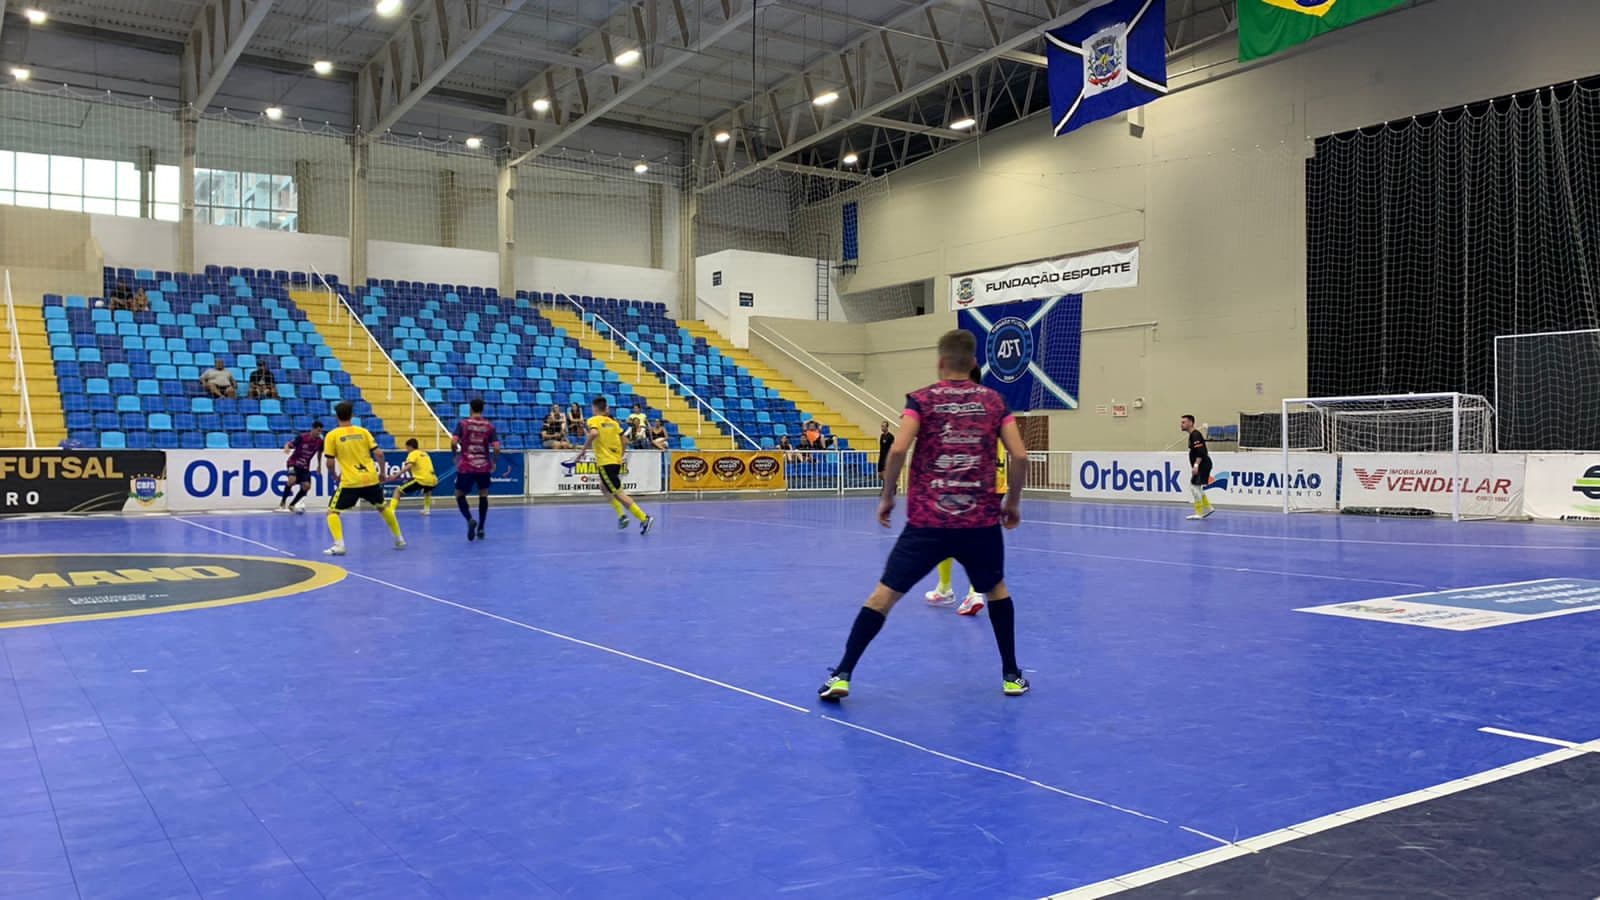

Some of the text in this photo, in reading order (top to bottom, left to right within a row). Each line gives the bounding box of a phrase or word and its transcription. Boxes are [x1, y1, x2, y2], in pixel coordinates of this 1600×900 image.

[985, 261, 1131, 292] FUNDAÇÃO ESPORTE
[0, 456, 124, 480] FUTSAL
[1080, 460, 1182, 492] Orbenk
[1231, 469, 1322, 489] TUBARÃO
[1387, 476, 1512, 495] VENDELAR
